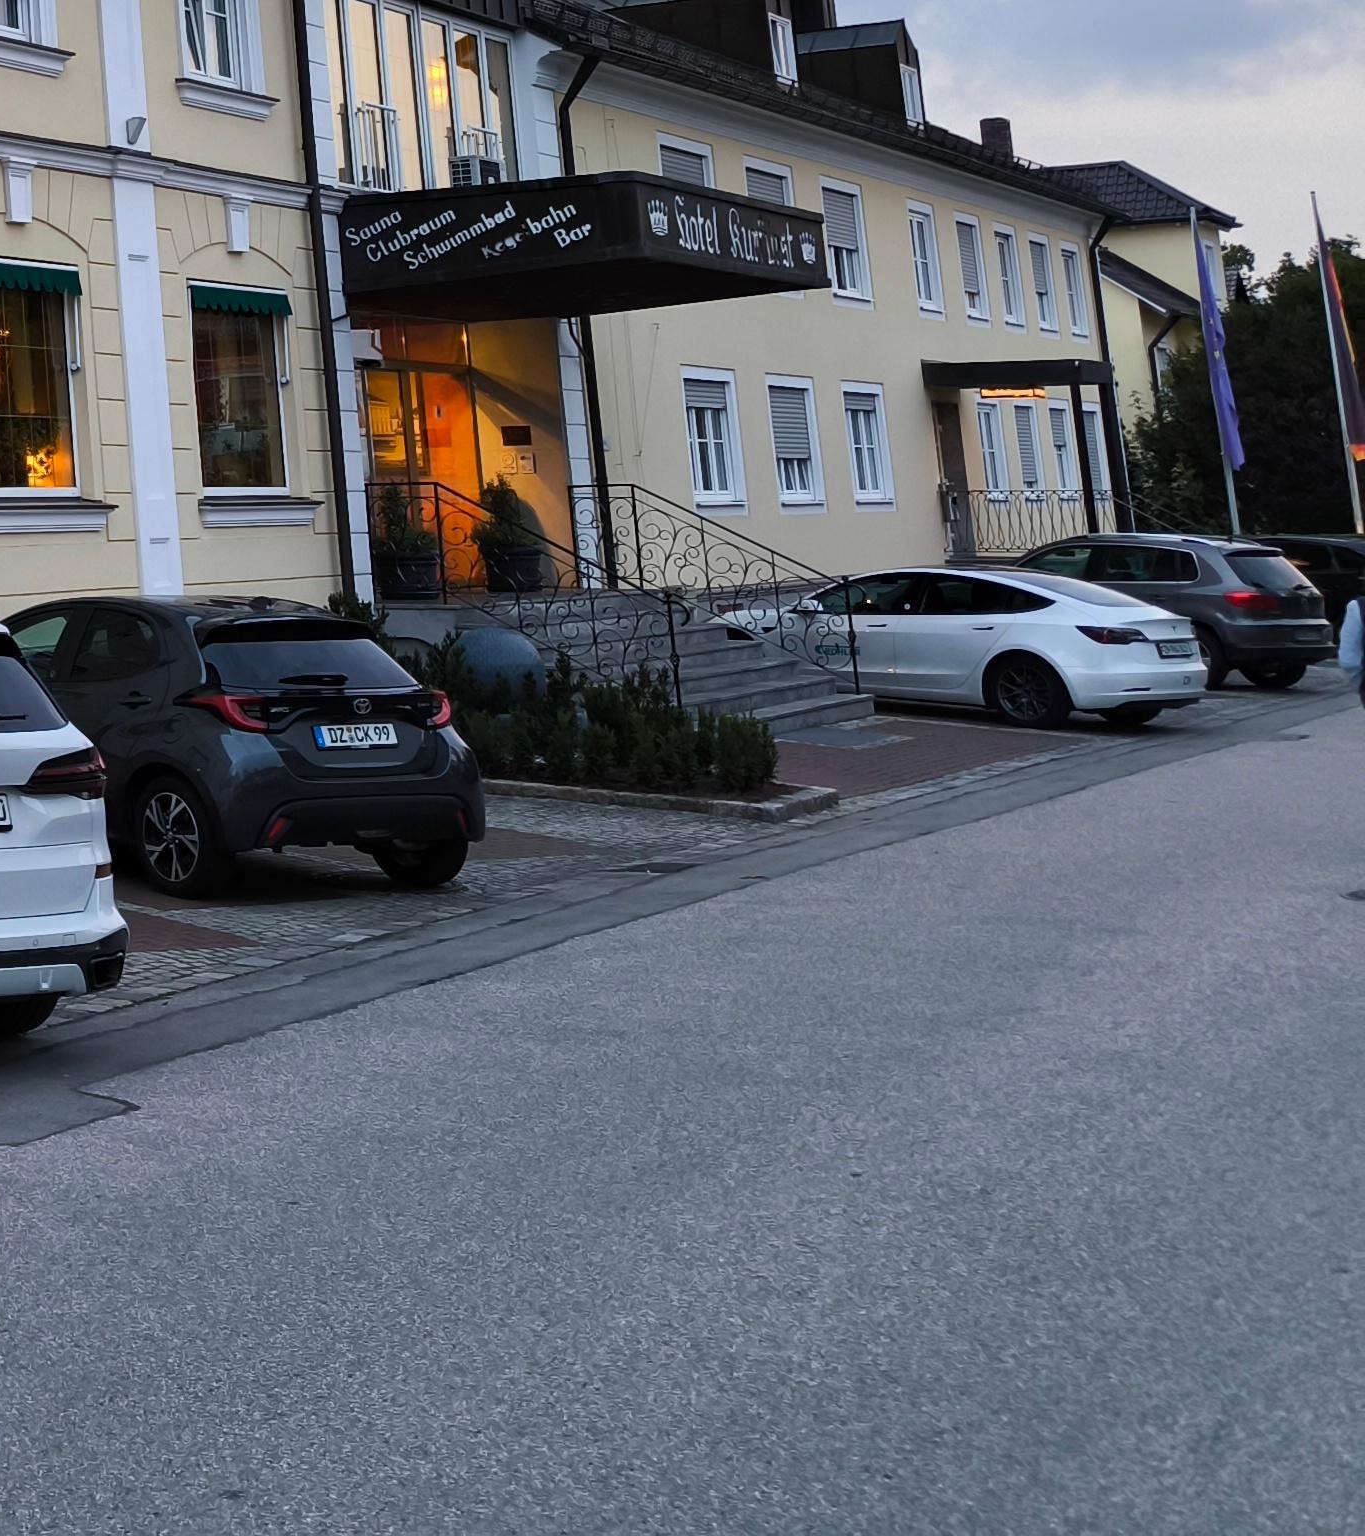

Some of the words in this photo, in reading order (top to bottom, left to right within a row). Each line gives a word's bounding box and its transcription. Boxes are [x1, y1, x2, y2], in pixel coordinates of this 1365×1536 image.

[345, 210, 402, 247] Sauna
[366, 209, 457, 263] Clubraum
[403, 200, 517, 270] Schwimmbad
[481, 202, 578, 260] Kegebahn
[553, 222, 593, 249] Bar
[675, 195, 721, 255] Hotel
[327, 727, 348, 743] DZ
[354, 726, 374, 743] CK
[374, 725, 390, 741] 99
